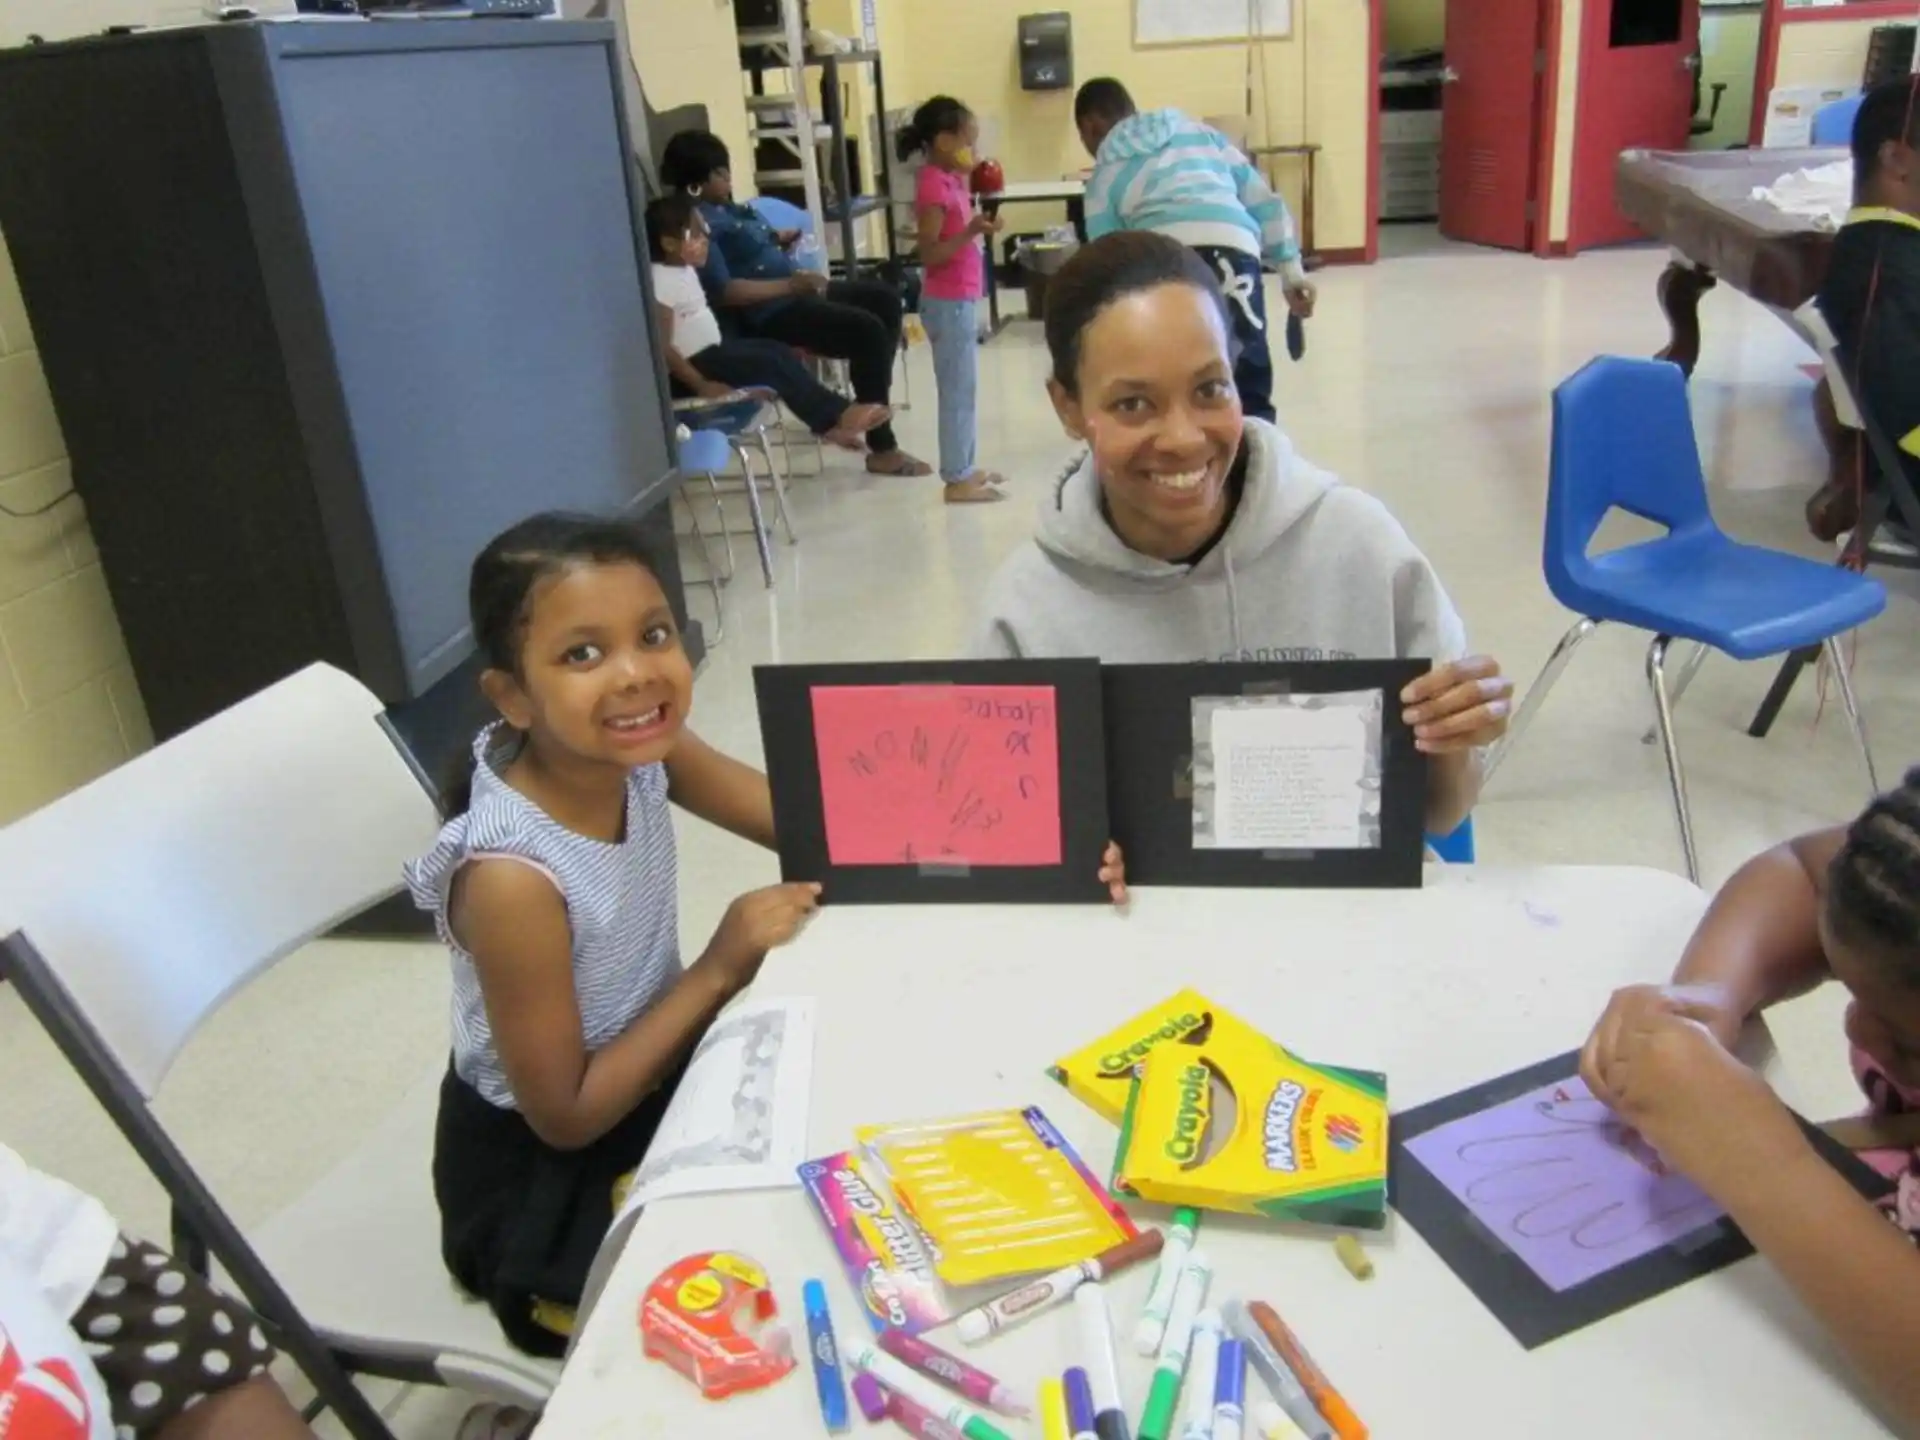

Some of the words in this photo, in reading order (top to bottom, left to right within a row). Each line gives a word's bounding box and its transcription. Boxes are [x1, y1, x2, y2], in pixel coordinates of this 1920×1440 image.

[1164, 1065, 1208, 1161] Crayola
[1263, 1079, 1305, 1172] MARKERS
[832, 1169, 885, 1213] Glue
